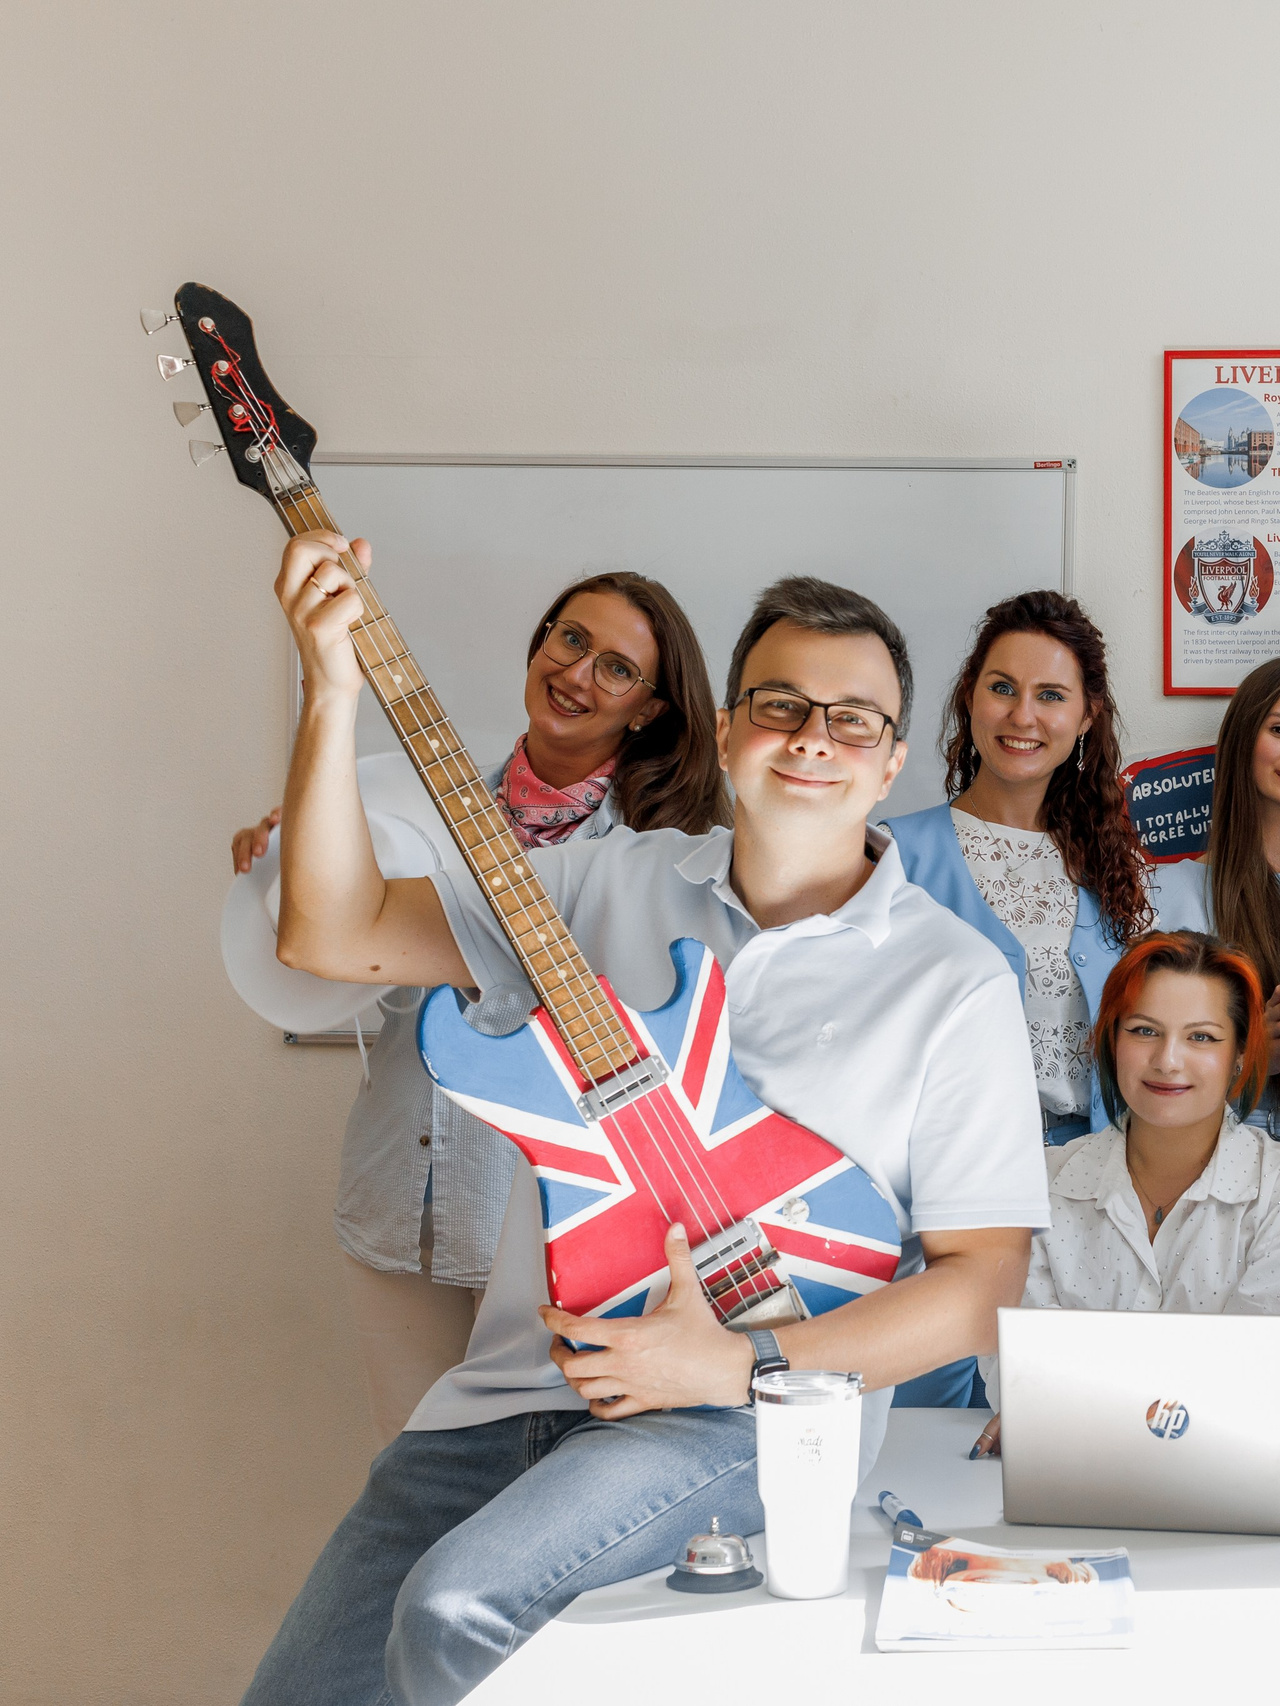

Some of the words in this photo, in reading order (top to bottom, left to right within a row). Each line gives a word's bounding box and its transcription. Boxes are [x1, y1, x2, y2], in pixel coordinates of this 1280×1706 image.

[1248, 489, 1271, 497] English
[1201, 566, 1247, 574] LIVERPOOL
[1136, 820, 1140, 831] I
[1146, 805, 1209, 828] TOTALLY
[1140, 825, 1185, 846] AGREE
[1190, 820, 1212, 835] WIT
[1151, 1398, 1187, 1440] hp
